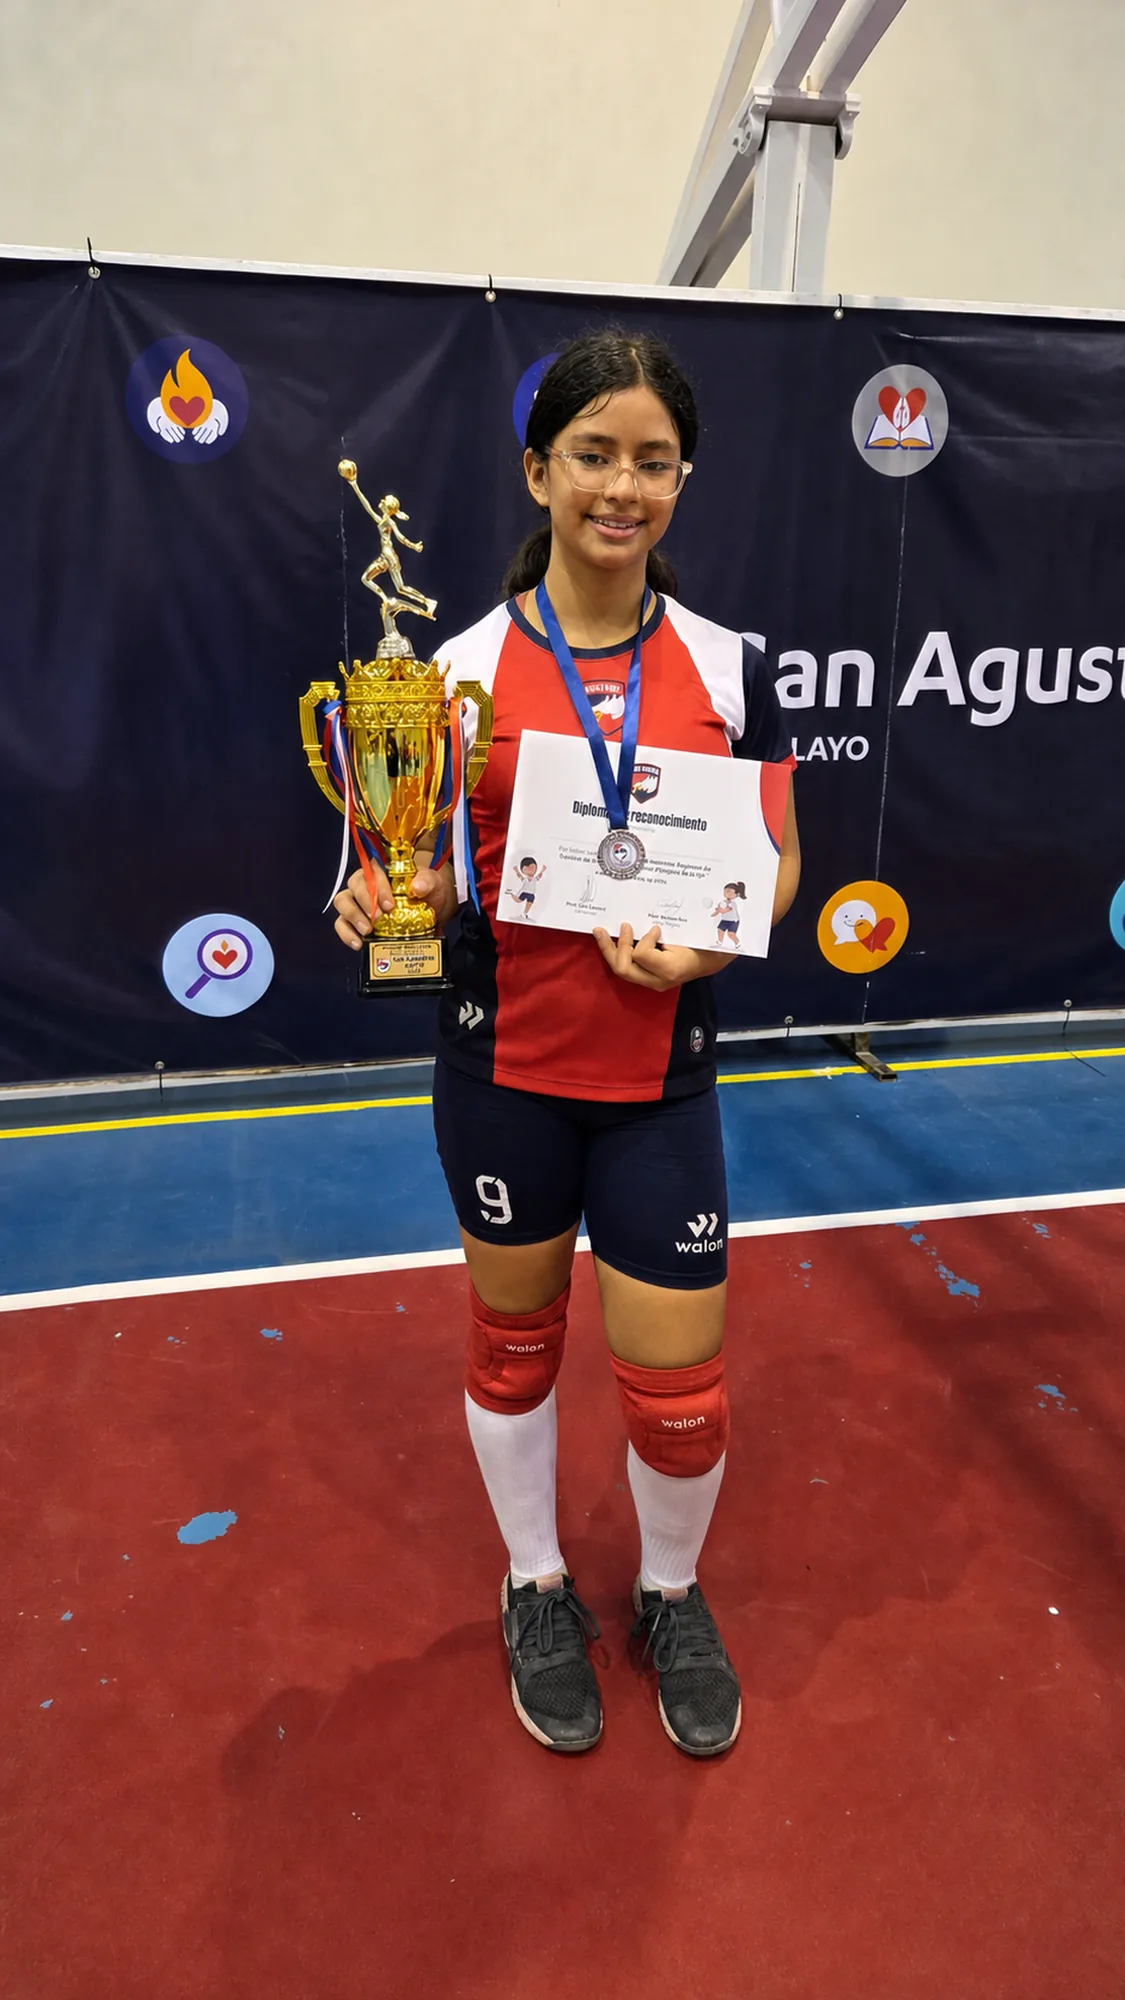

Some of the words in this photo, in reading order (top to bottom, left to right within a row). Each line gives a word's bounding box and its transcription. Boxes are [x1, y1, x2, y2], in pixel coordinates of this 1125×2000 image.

[739, 632, 875, 709] an
[897, 631, 1125, 726] Agus
[630, 810, 708, 832] reconocimiento
[475, 1174, 513, 1225] 9
[675, 1238, 723, 1254] walon
[506, 1343, 545, 1353] walon
[661, 1416, 706, 1430] walon
